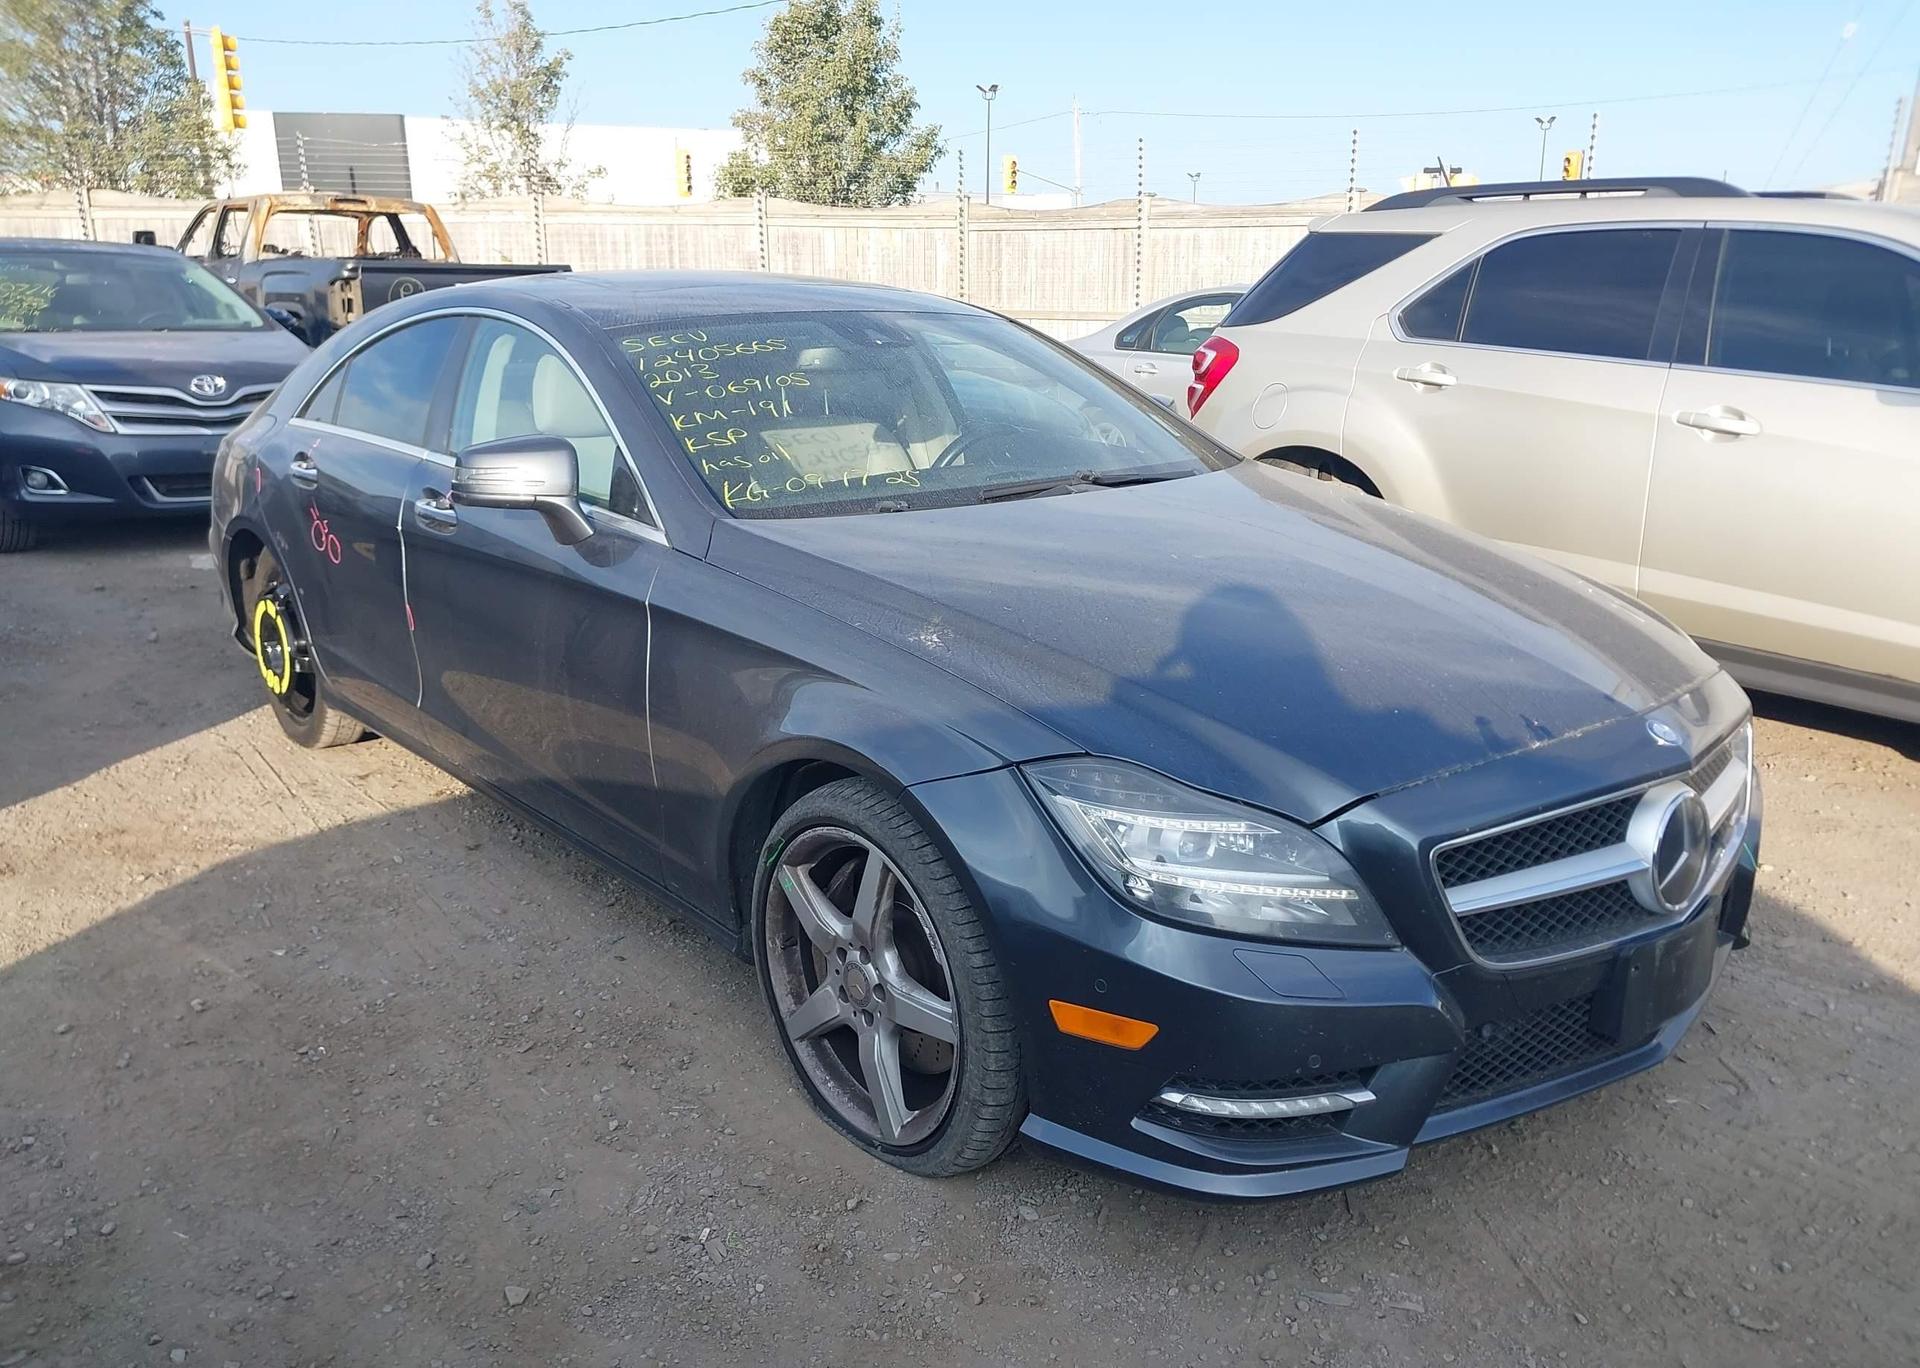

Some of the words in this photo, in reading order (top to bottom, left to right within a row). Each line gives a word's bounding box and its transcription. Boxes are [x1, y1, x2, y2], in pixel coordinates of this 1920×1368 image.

[622, 330, 708, 353] SECV
[644, 363, 720, 389] 2013
[684, 427, 748, 453] KSP
[702, 455, 753, 475] has
